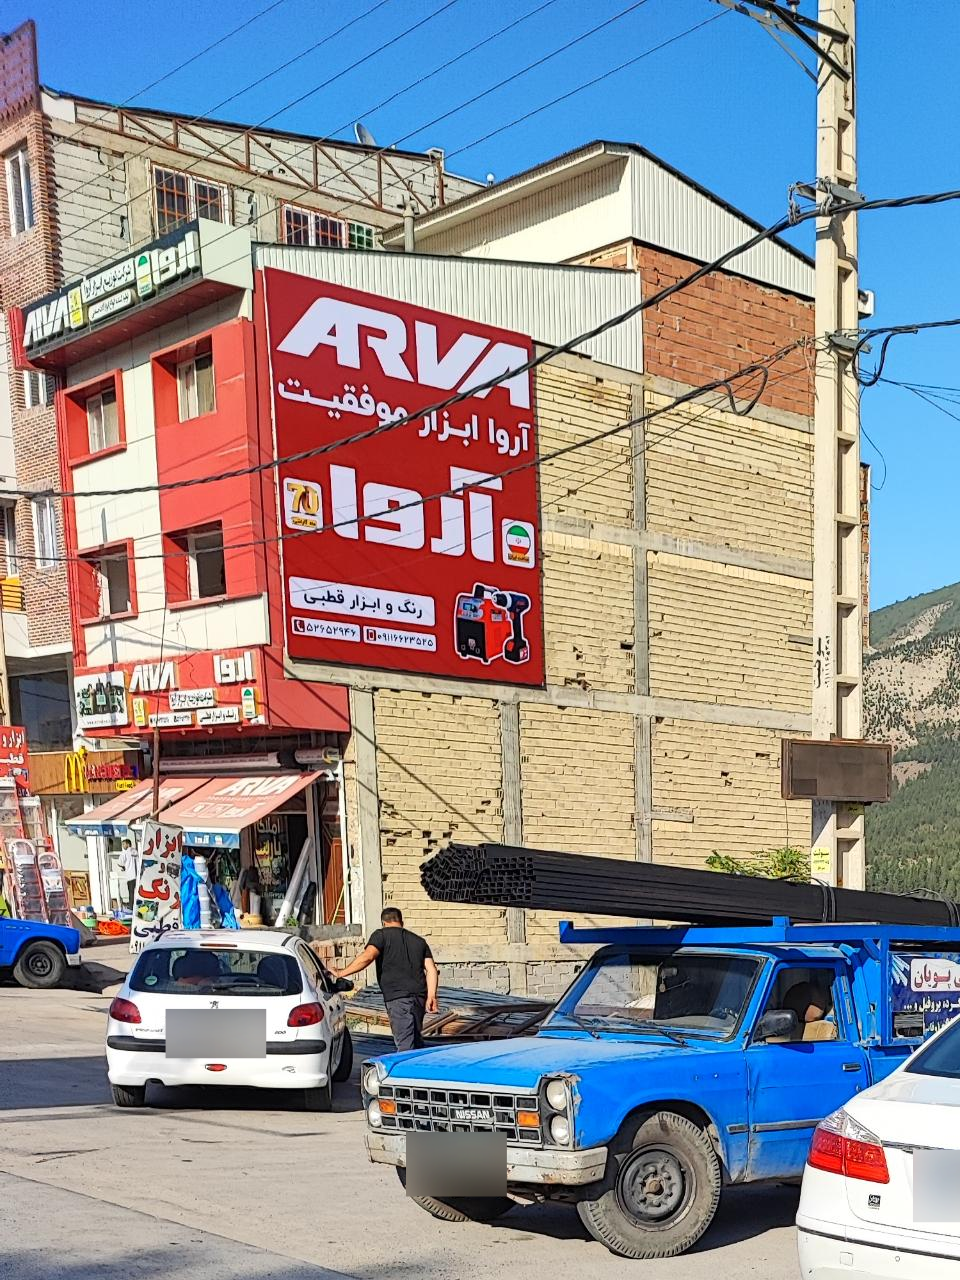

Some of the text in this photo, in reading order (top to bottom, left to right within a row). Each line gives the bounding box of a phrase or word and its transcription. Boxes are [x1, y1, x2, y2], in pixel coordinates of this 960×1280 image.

[276, 296, 531, 410] ARVA
[278, 378, 531, 457] آروا ابزار موفقیت
[287, 482, 320, 516] 70
[330, 464, 503, 563] آروا
[303, 589, 423, 619] رنگ و ابزار قطبی
[306, 622, 357, 639] ۵۲۶۵۲۹۴۶
[143, 827, 183, 859] ابزار
[158, 862, 166, 874] و
[133, 917, 180, 943] قطبی
[455, 1109, 490, 1120] NISSAN
